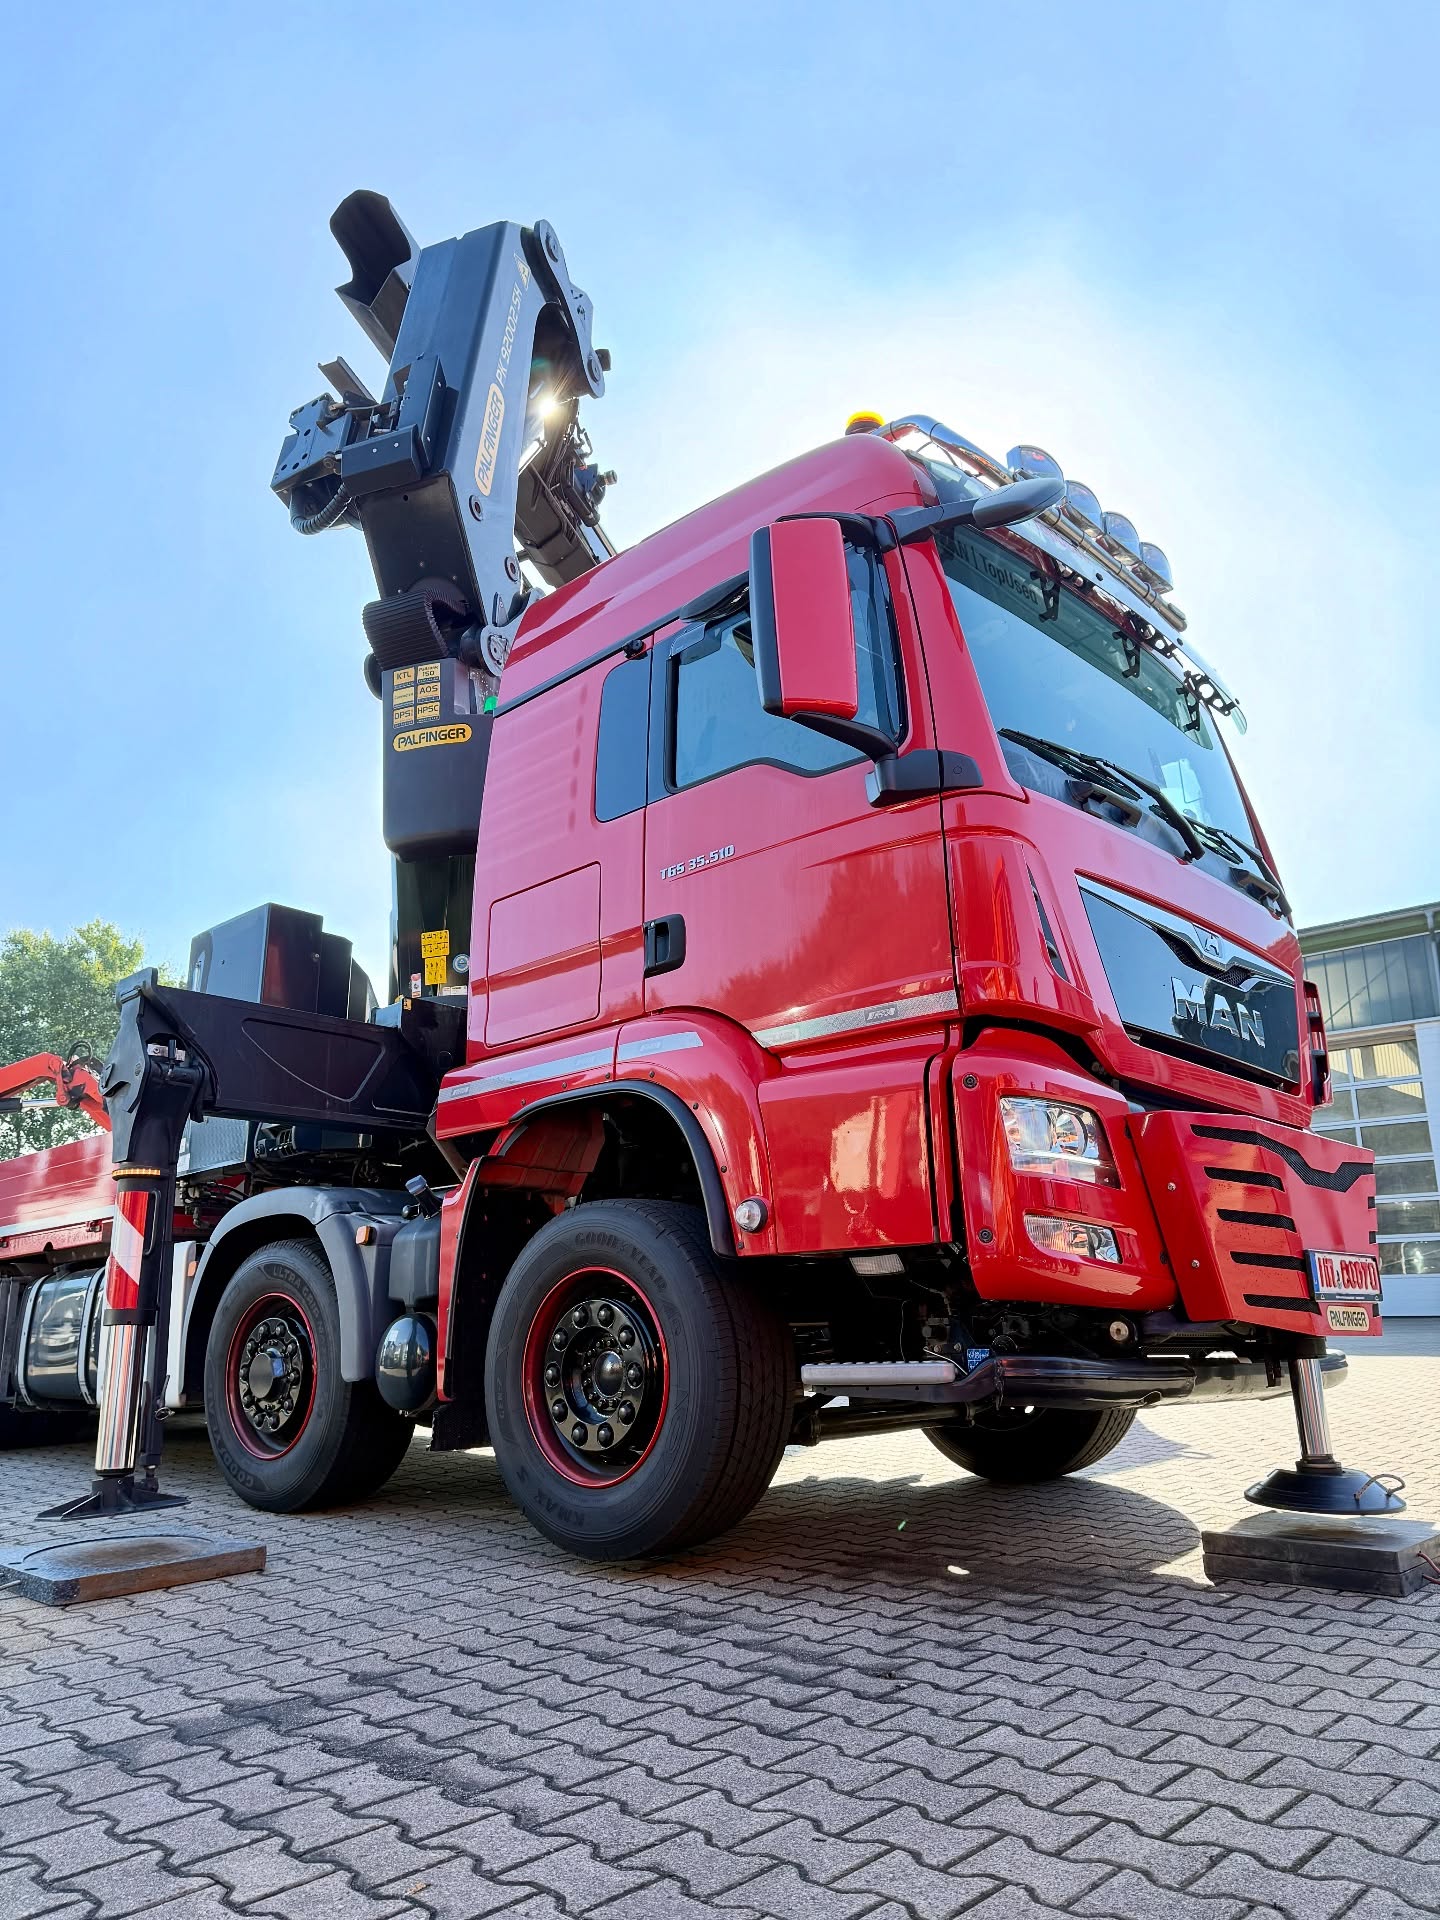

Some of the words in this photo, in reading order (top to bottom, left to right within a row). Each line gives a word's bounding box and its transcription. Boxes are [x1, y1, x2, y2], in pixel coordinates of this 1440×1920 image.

[478, 391, 503, 489] PALFINGER
[496, 361, 508, 389] PK
[397, 671, 411, 679] KTL
[419, 684, 438, 694] AOS
[417, 704, 439, 714] HPSC
[399, 728, 465, 748] PALFINGER
[688, 844, 735, 871] 35.510
[1171, 976, 1266, 1048] MAN
[1329, 1310, 1367, 1328] PALFINGER
